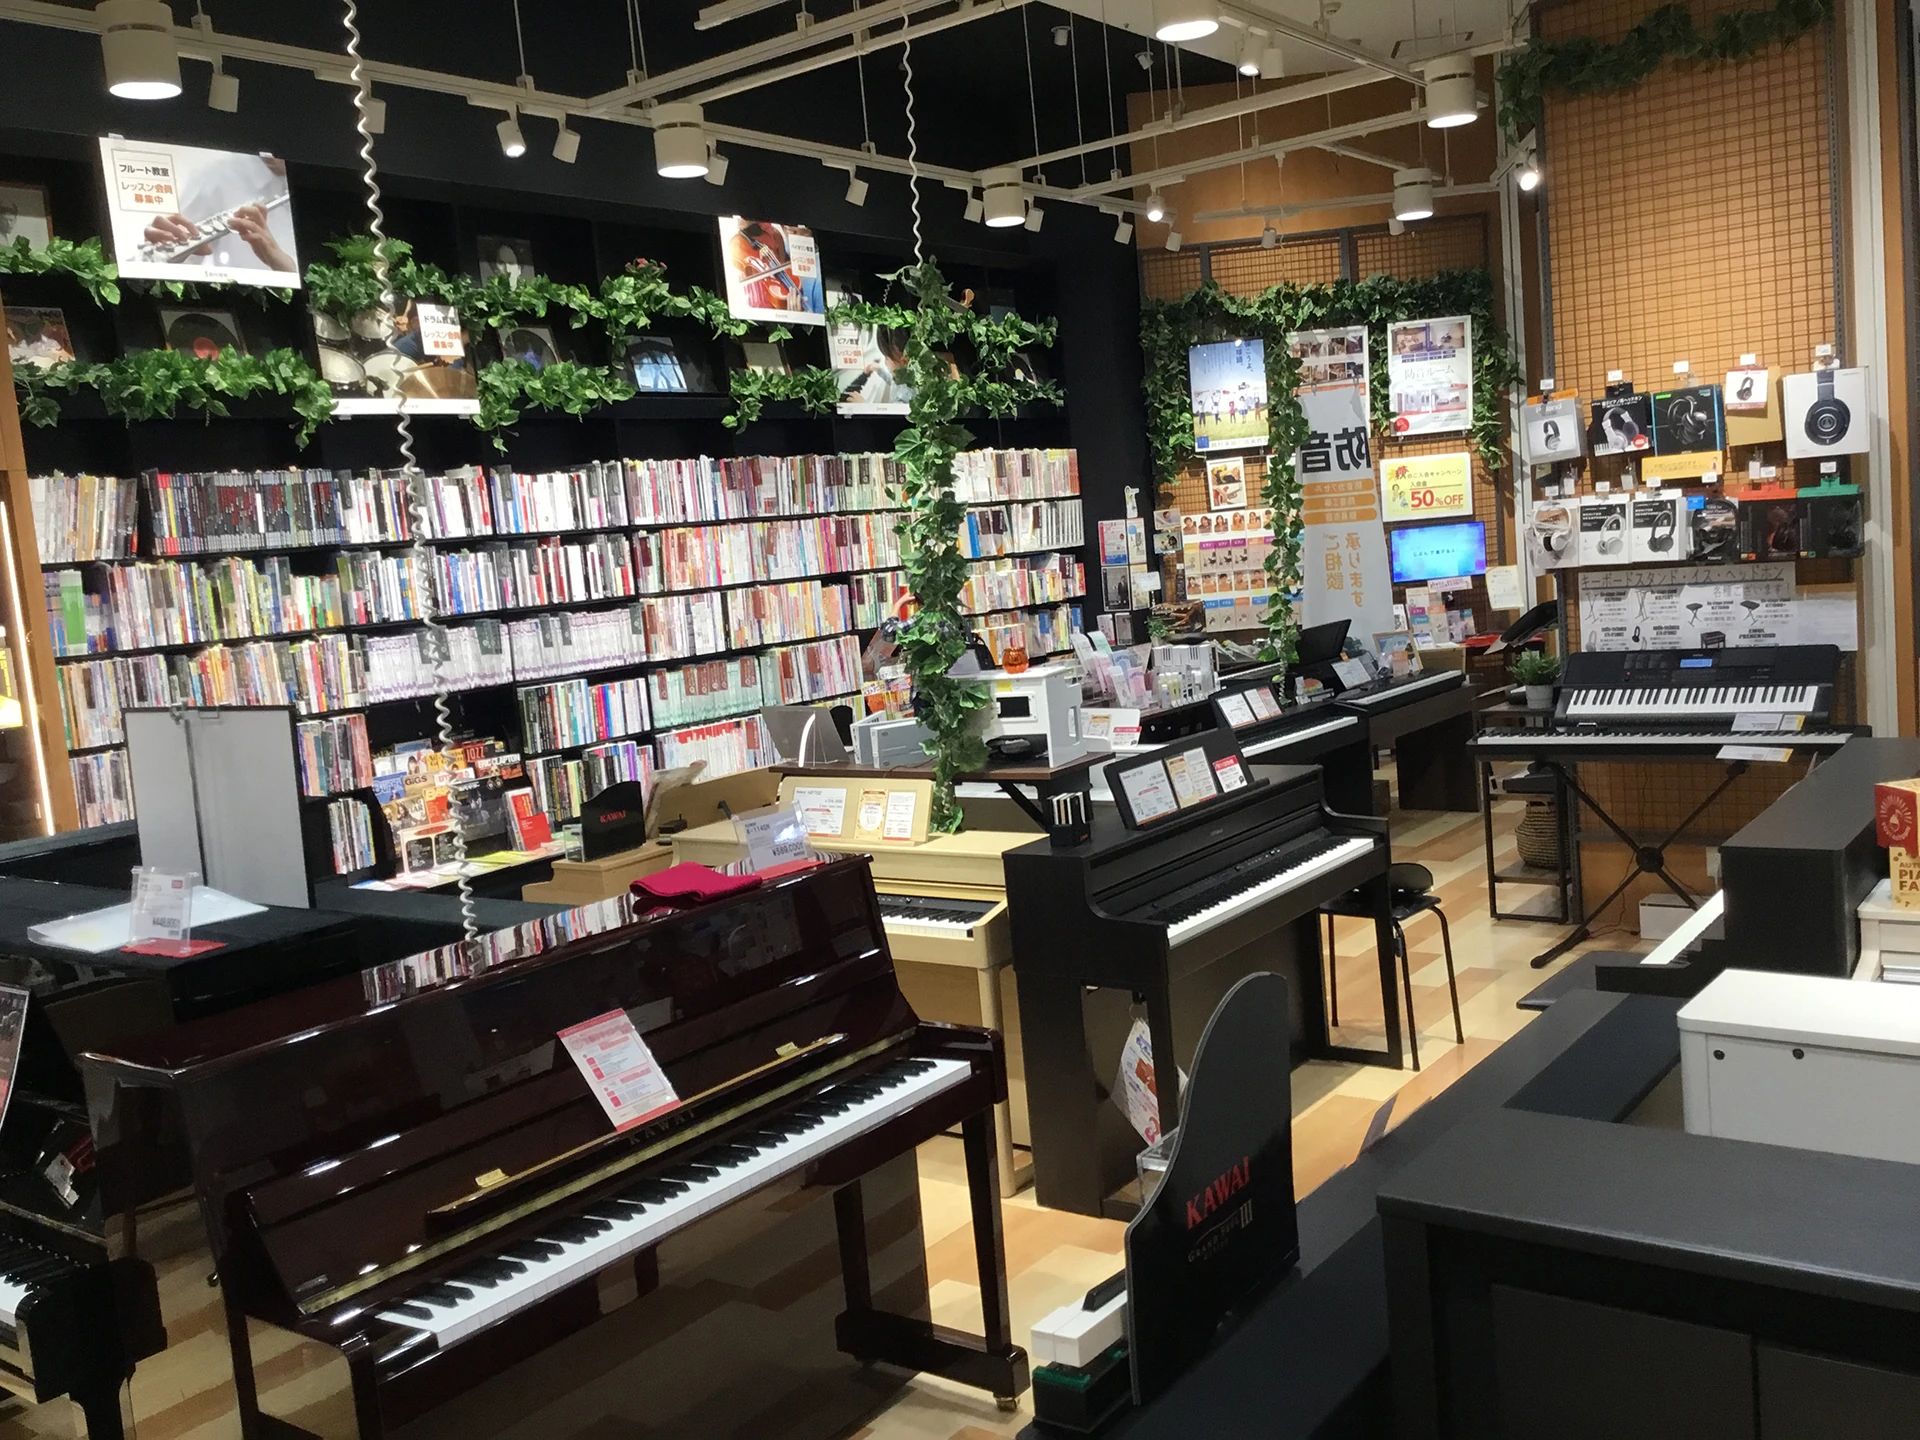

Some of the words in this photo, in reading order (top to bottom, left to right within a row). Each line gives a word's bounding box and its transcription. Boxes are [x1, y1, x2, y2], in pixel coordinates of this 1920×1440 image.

[119, 164, 169, 176] フルート教室
[121, 181, 173, 194] レッスン会員
[134, 194, 163, 204] 募集中
[600, 810, 625, 823] KAWAI
[1186, 1155, 1249, 1231] KAWAI
